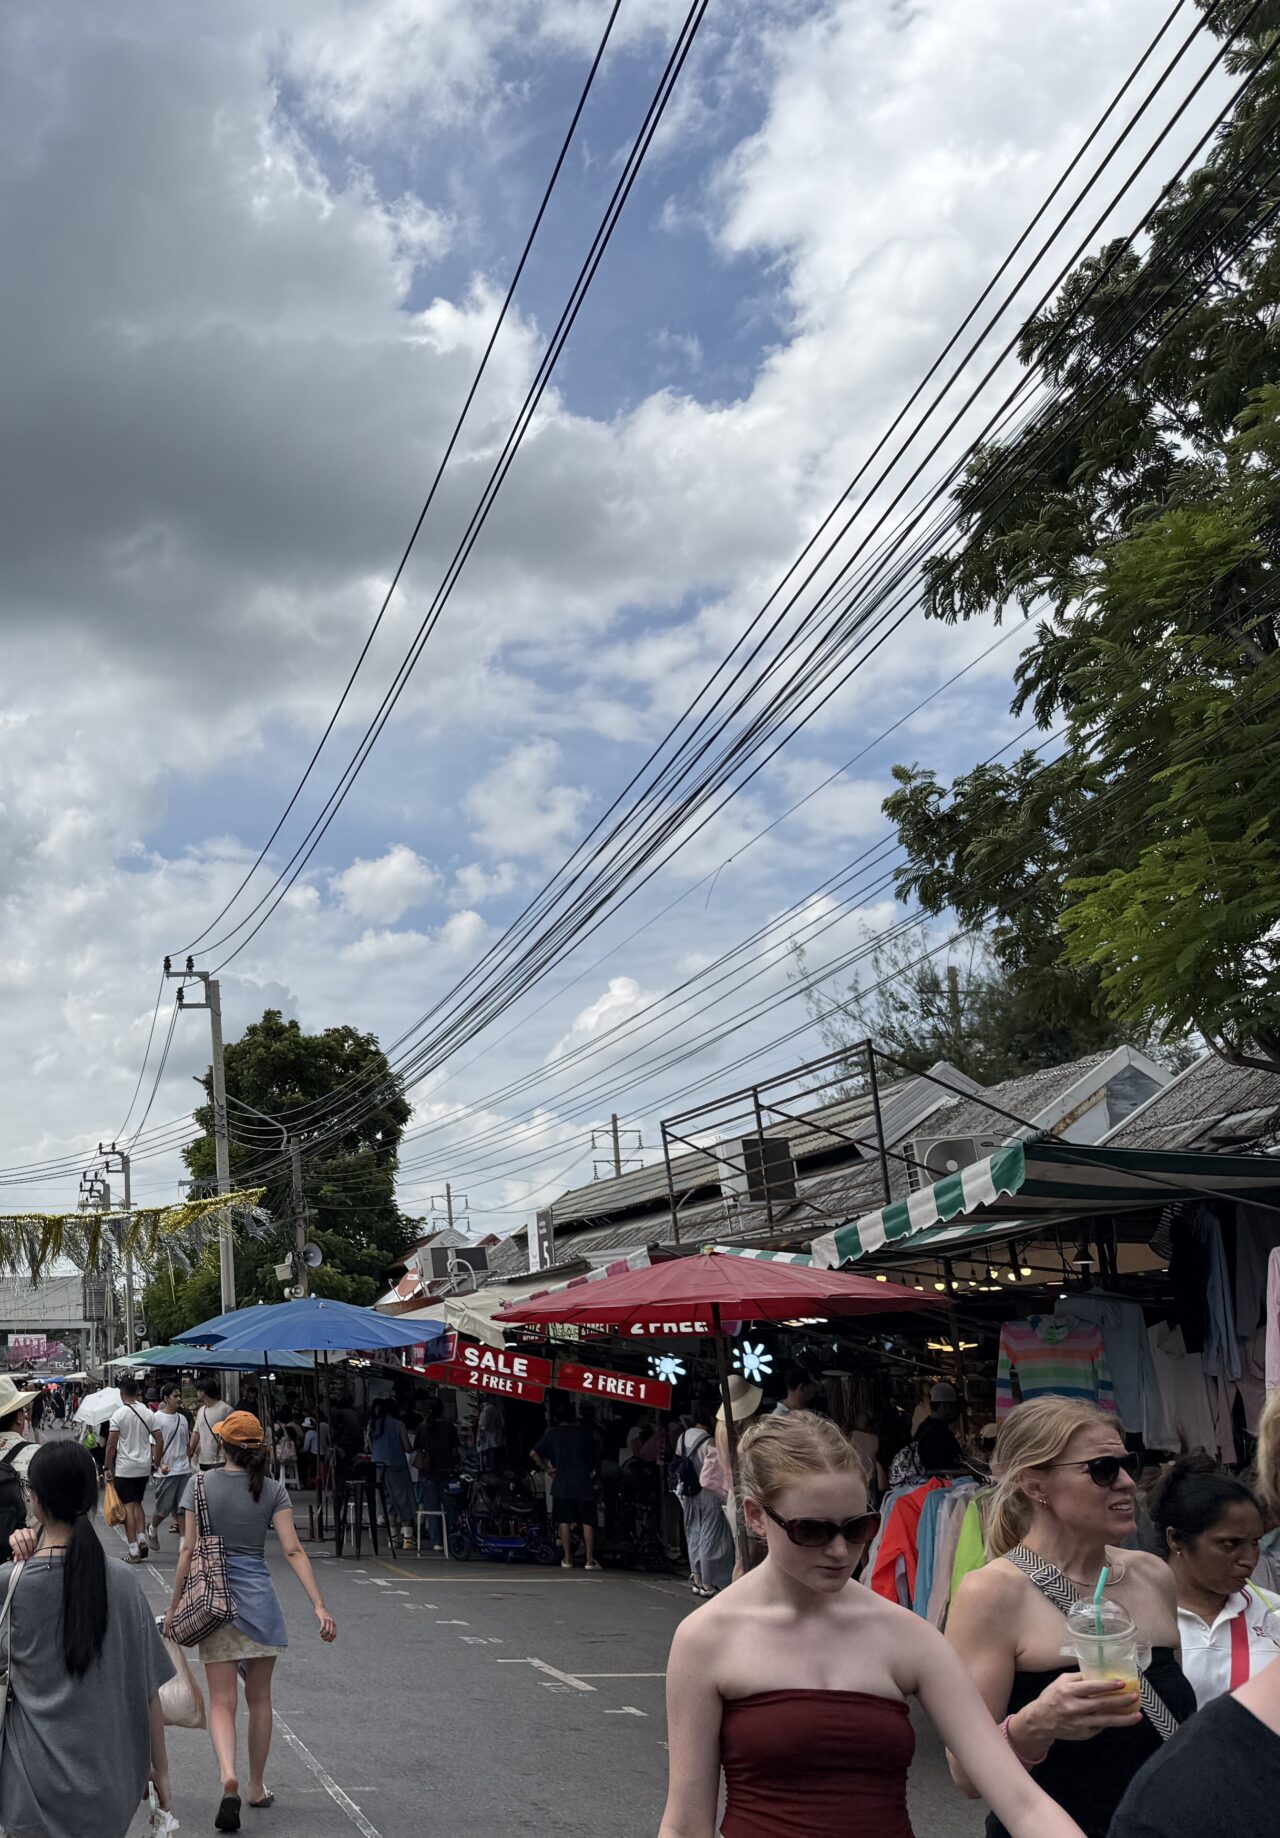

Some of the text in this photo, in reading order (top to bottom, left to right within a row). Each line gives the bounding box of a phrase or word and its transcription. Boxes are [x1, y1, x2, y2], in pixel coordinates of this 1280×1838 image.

[463, 1347, 529, 1378] SALE
[469, 1371, 523, 1395] 2 FREE 1
[582, 1372, 646, 1399] 2 FREE 1
